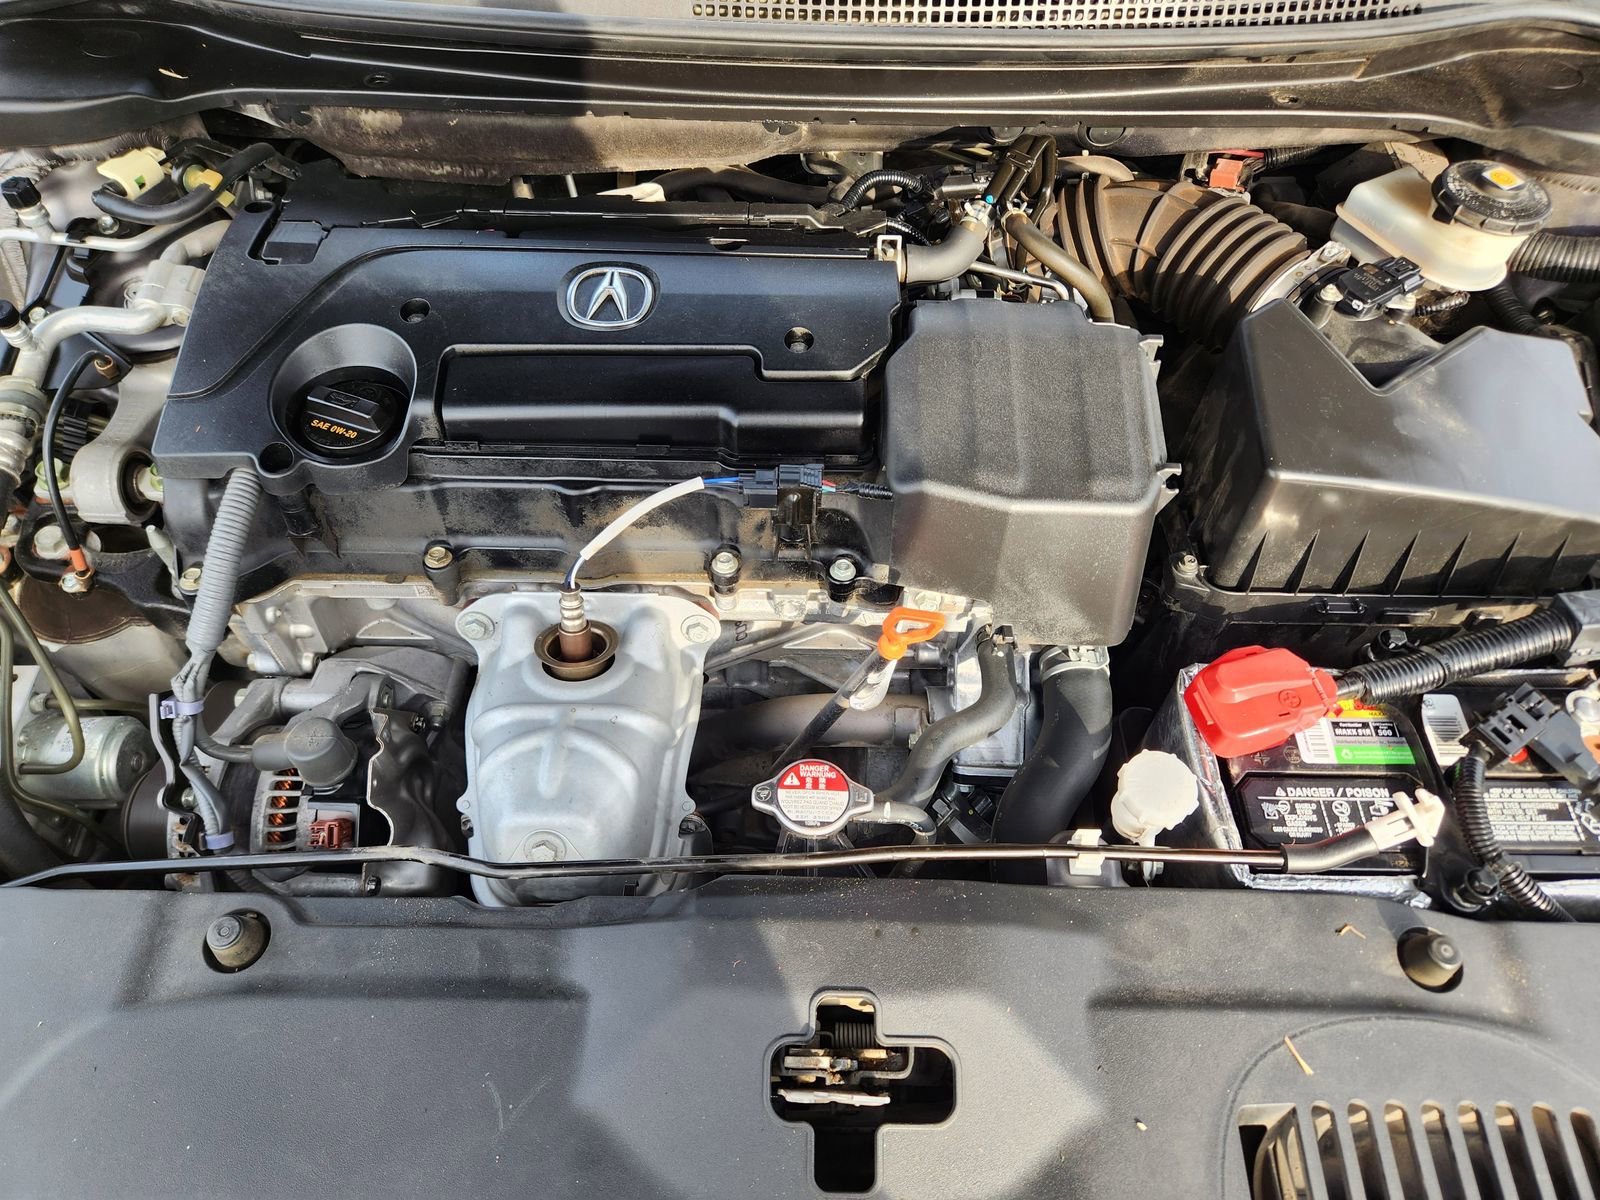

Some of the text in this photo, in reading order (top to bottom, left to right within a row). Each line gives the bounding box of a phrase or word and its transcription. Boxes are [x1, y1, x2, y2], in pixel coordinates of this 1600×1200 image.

[310, 419, 358, 439] SAE 0W-20
[1334, 728, 1357, 737] MAXX
[1377, 729, 1393, 737] 500
[799, 764, 830, 772] DANGER
[800, 770, 837, 779] WARNUNG
[1287, 787, 1390, 798] DANGER / POISON
